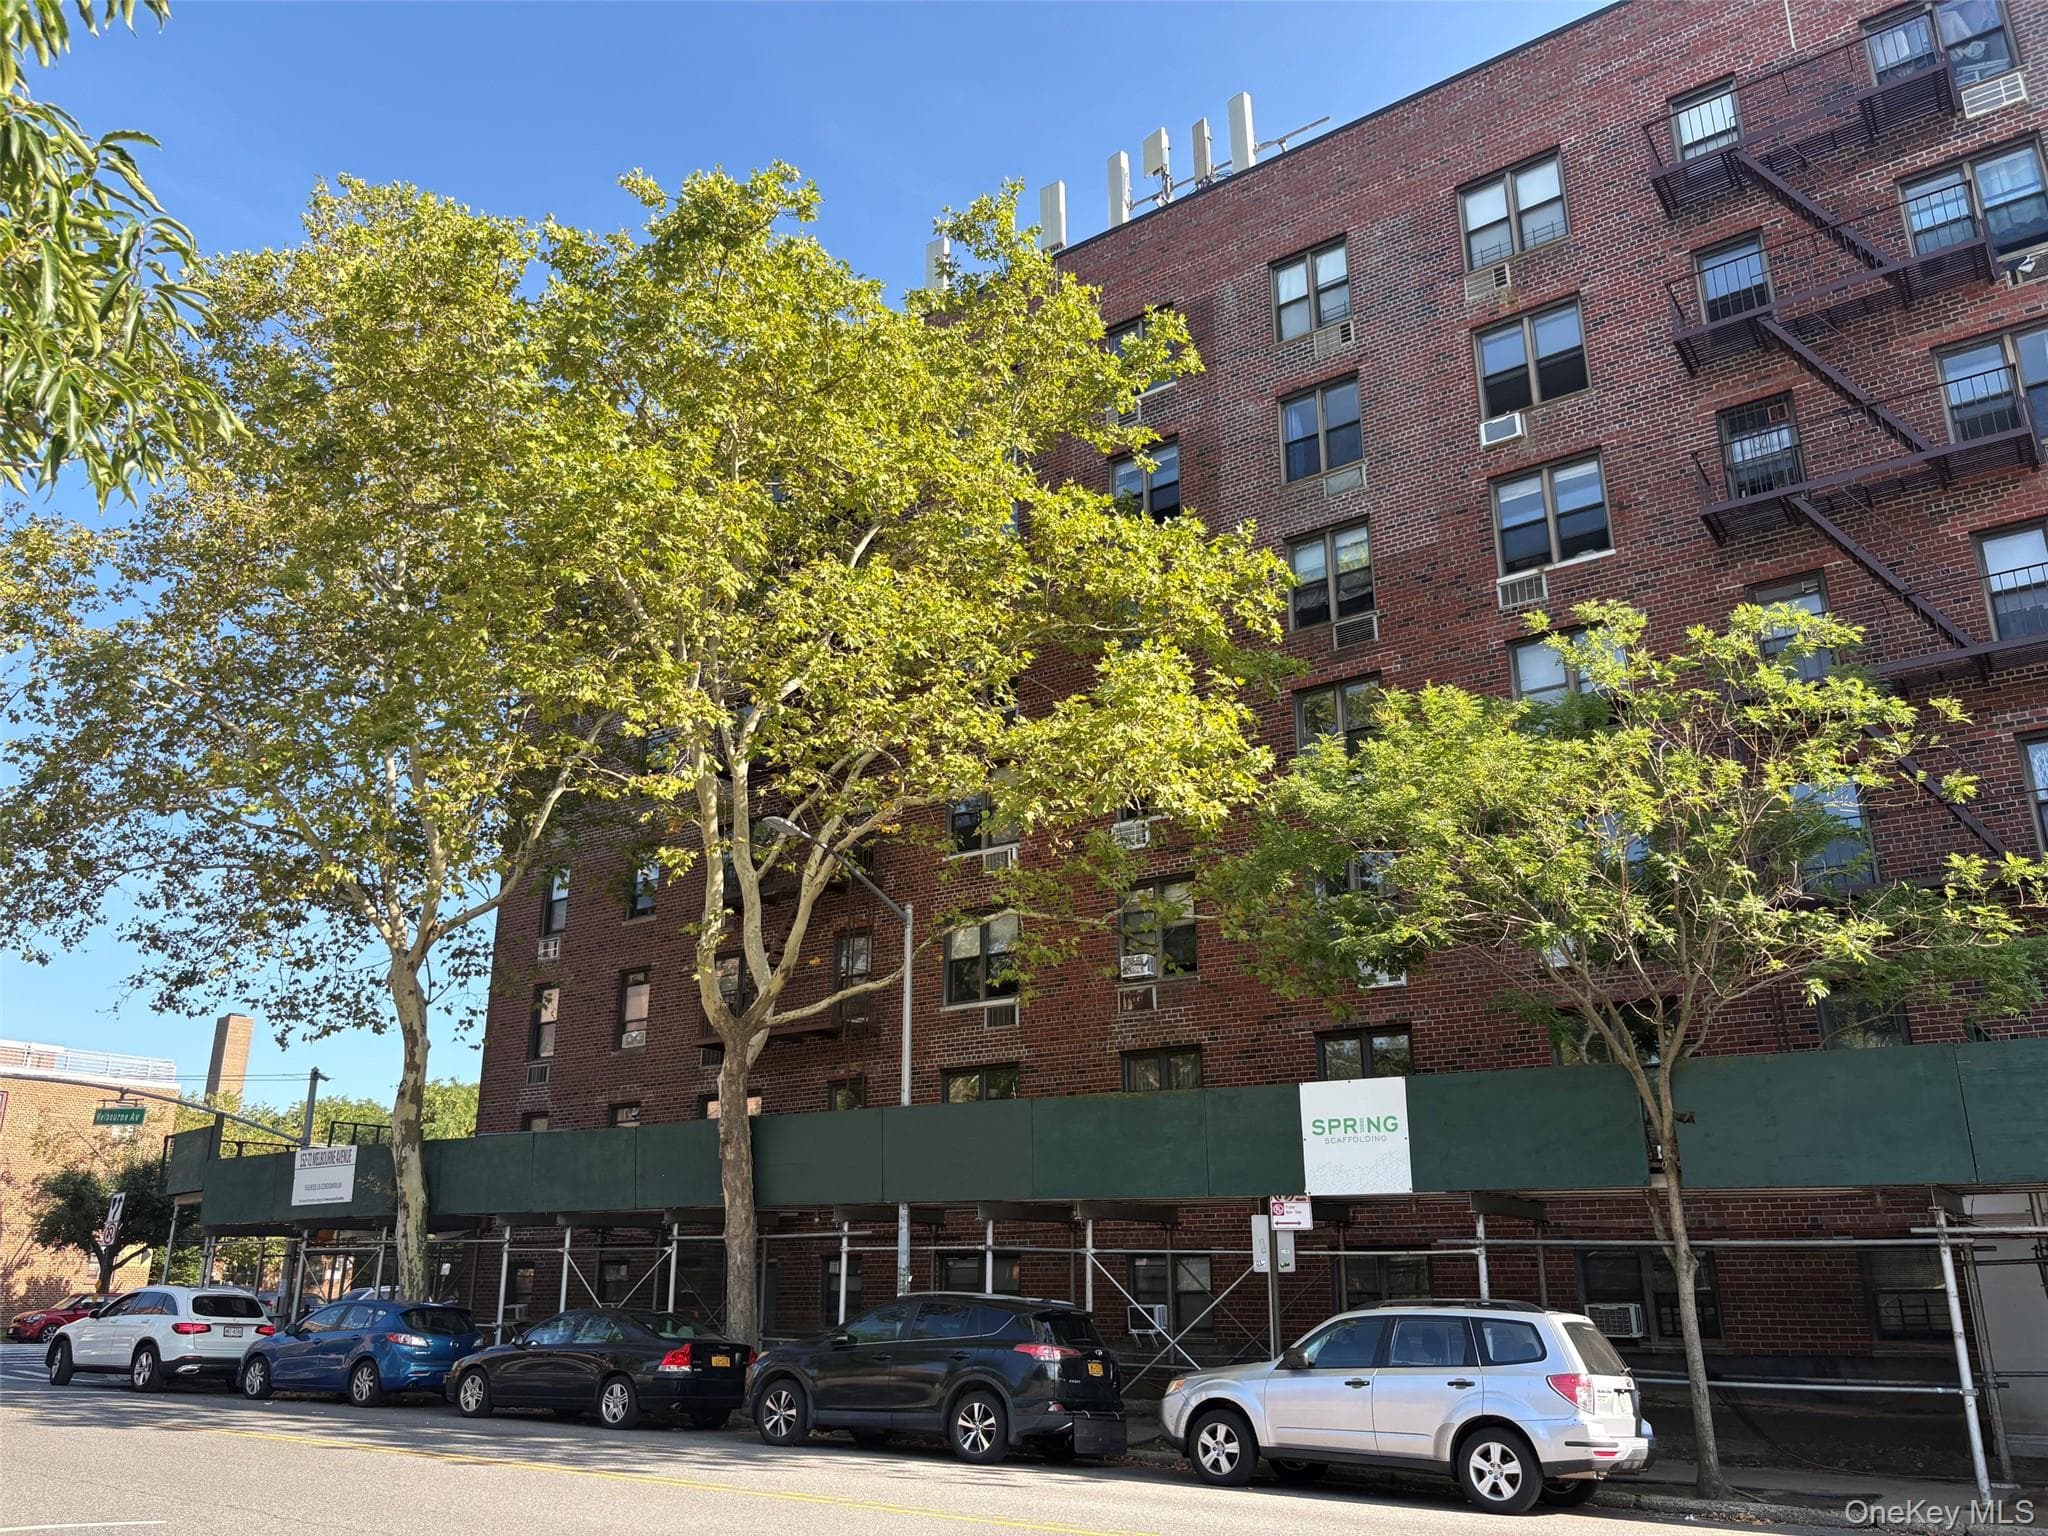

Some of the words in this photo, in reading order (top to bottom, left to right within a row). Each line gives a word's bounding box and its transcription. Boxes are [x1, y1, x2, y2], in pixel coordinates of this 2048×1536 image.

[129, 1111, 140, 1121] Av
[1311, 1115, 1398, 1135] SPRING
[1324, 1135, 1387, 1144] SCAFFOLDING
